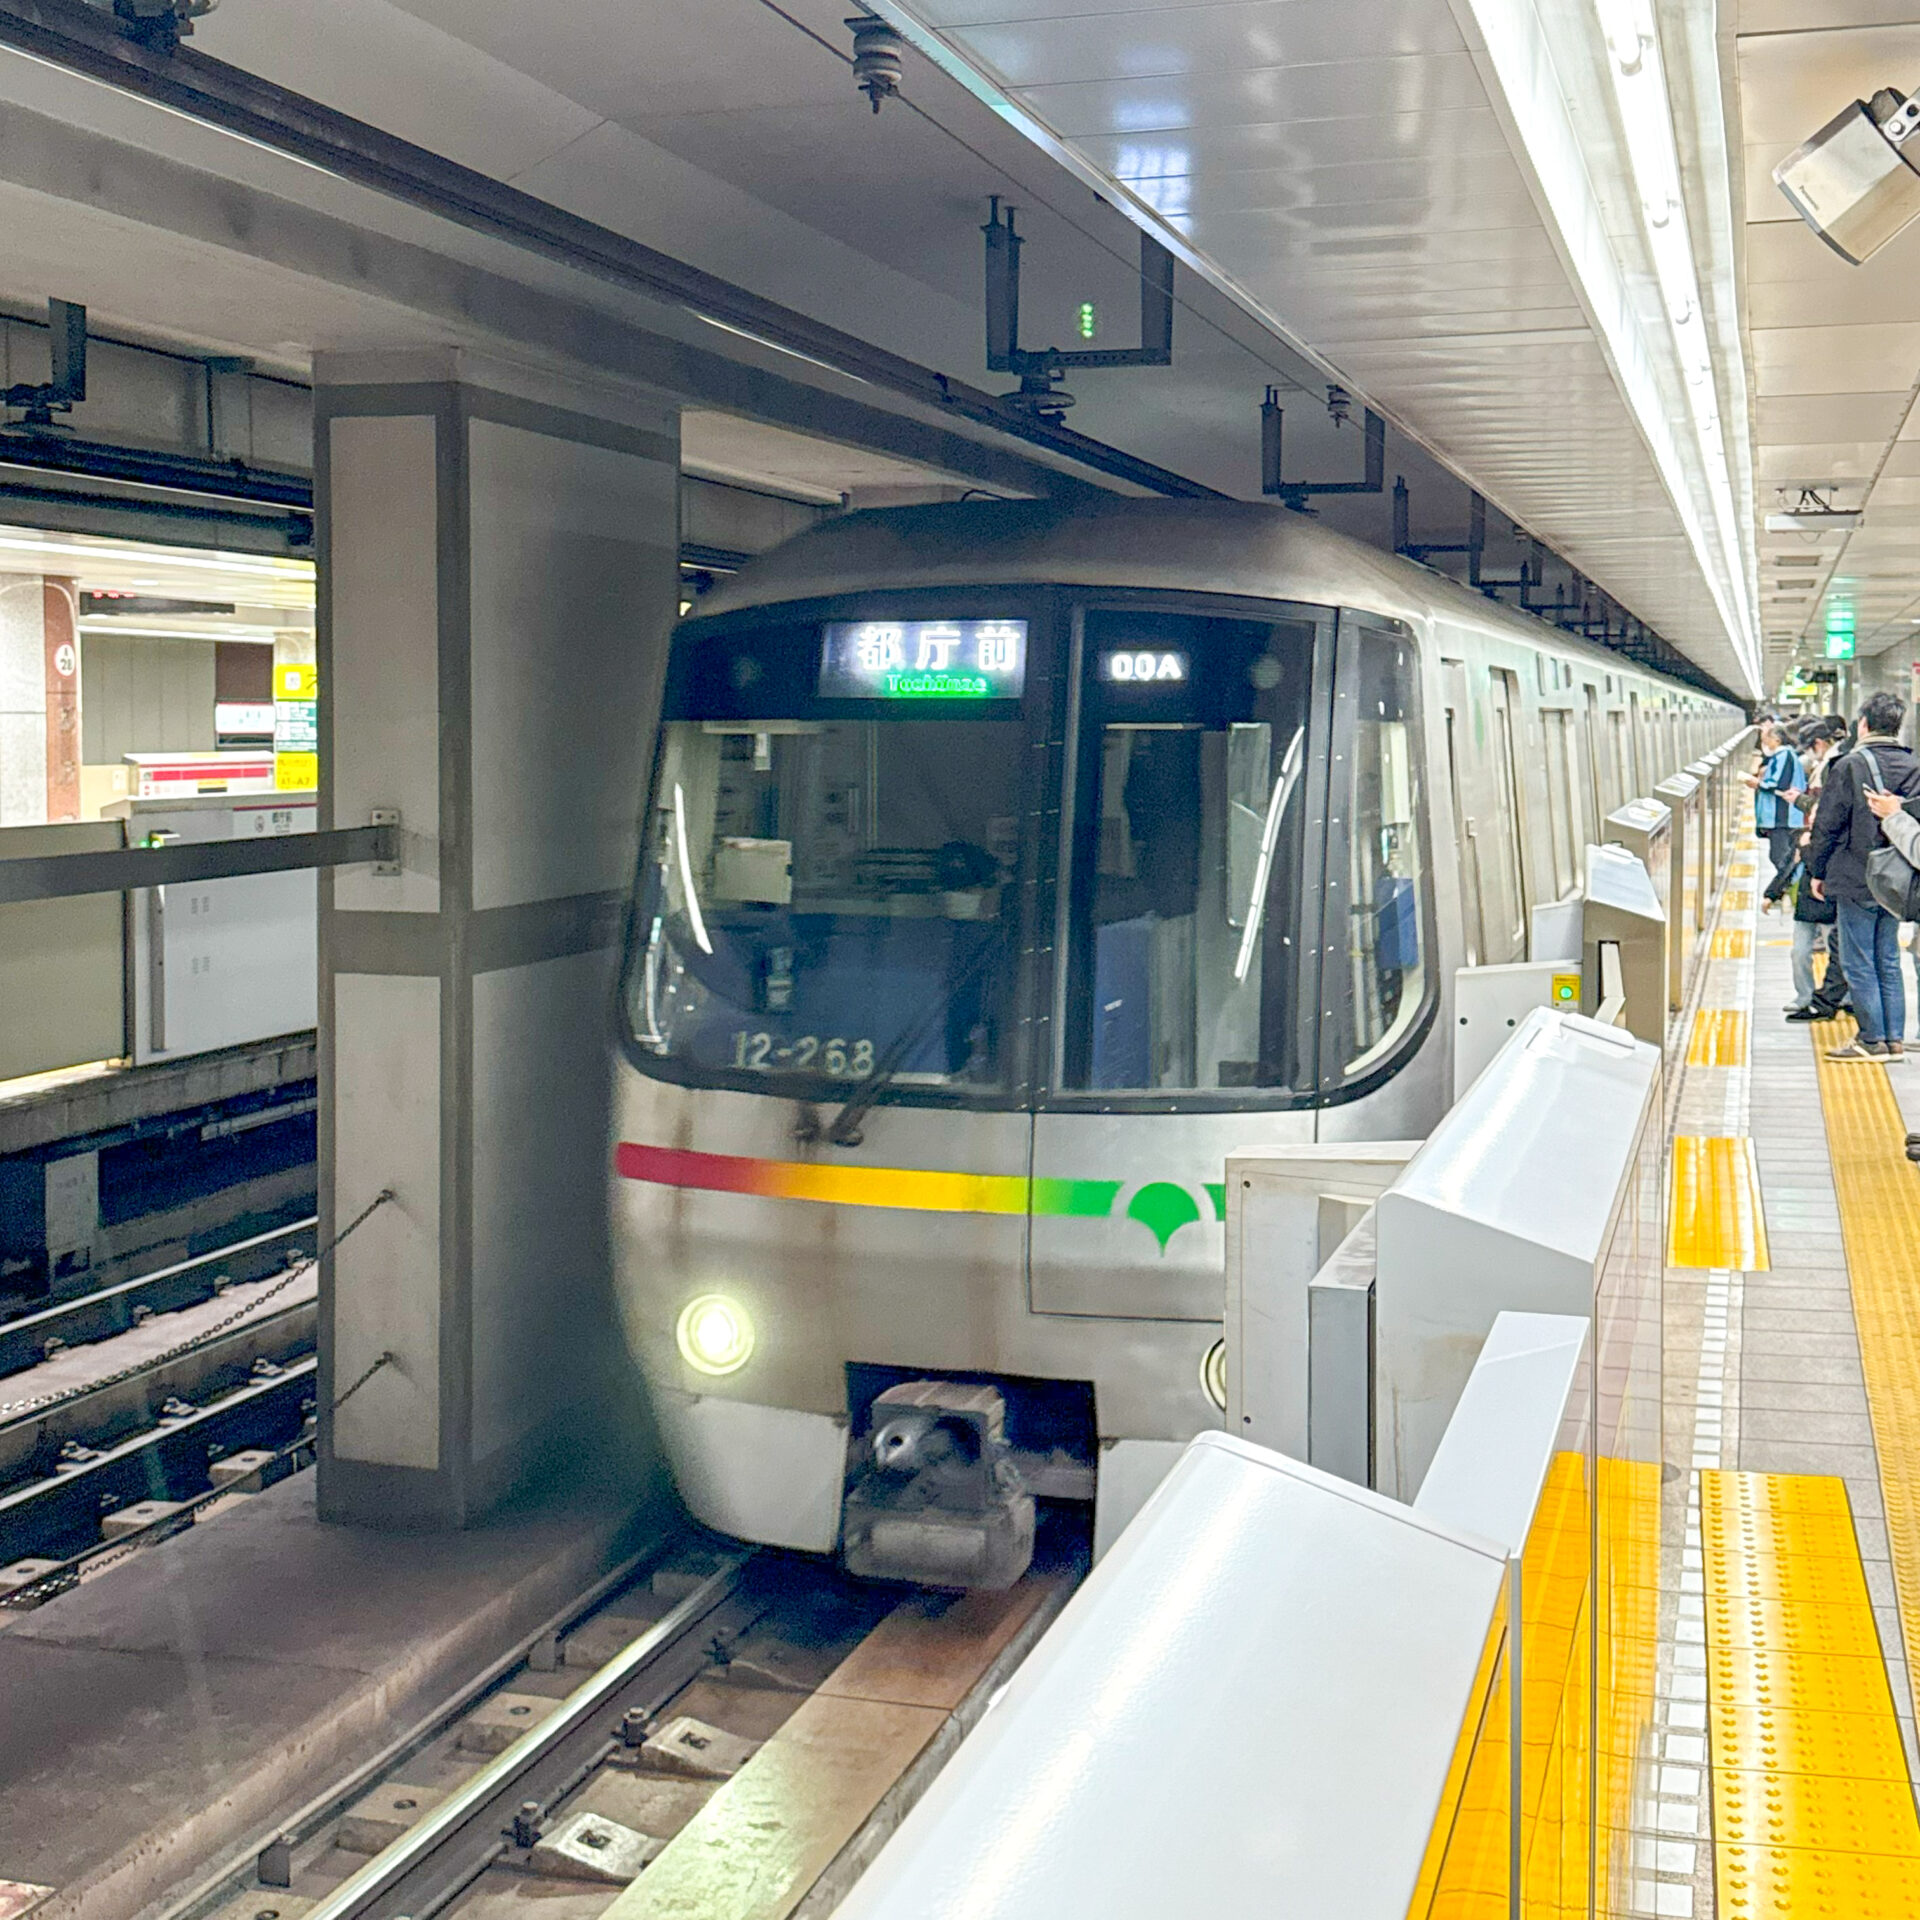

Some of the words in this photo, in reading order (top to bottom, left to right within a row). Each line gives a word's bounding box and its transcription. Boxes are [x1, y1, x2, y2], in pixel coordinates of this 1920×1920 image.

[857, 626, 1020, 670] 都庁前
[1111, 653, 1182, 680] 00A
[732, 1030, 874, 1077] 12-268
